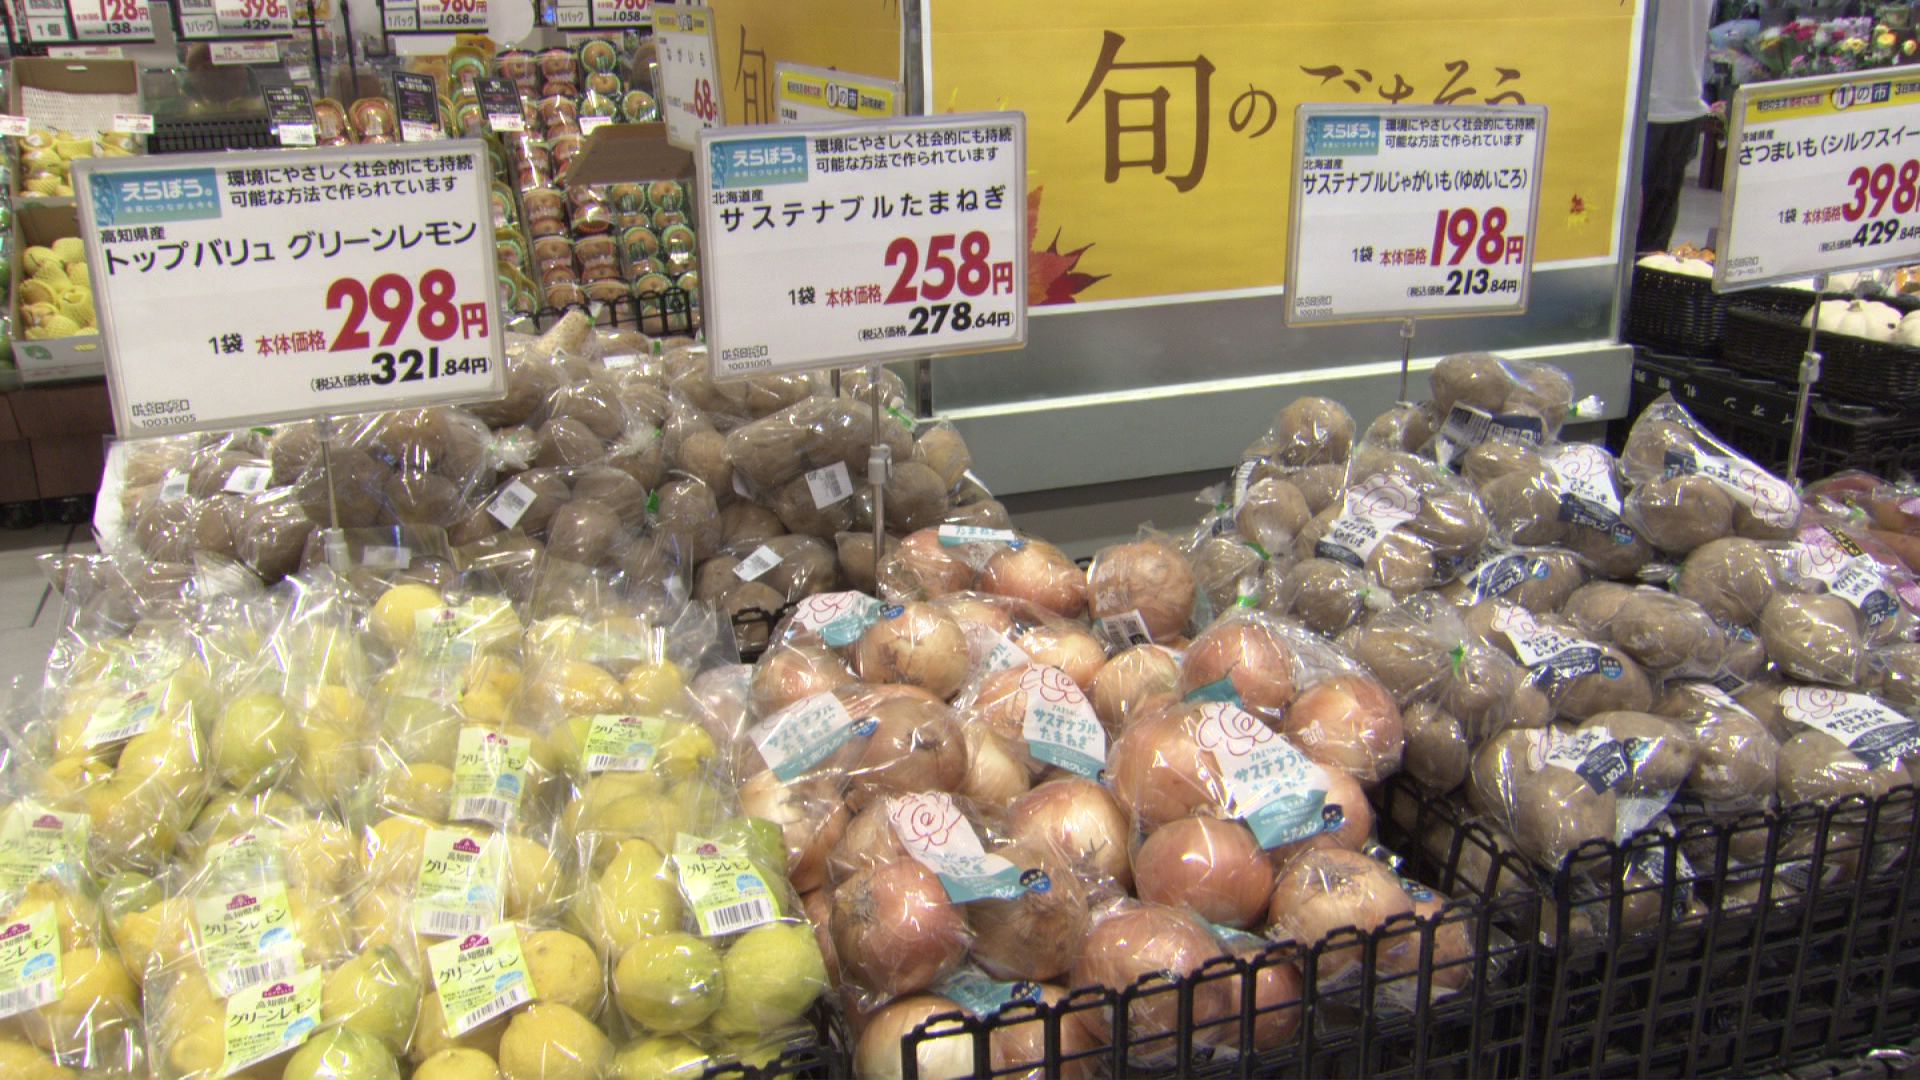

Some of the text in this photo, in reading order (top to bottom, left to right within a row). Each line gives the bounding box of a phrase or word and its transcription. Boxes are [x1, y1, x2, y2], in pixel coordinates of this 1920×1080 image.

[1385, 117, 1536, 132] 環境にやさしく社会的にも持続
[814, 127, 1012, 153] 環境にやさしく社会的にも持続
[1385, 134, 1525, 149] 可能な方法で作られています
[816, 147, 999, 173] 可能な方法で作られています
[1303, 158, 1344, 171] 北海道産
[226, 155, 473, 188] 環境にやさしく社会的にも持続
[230, 177, 458, 208] 可能な方法で作られています
[712, 189, 764, 206] 北海道産
[100, 226, 166, 244] 高知県産
[105, 221, 478, 275] トップバリュ グリーンレモン
[1351, 246, 1373, 263] 1袋
[788, 287, 816, 306] 1袋
[208, 333, 244, 356] 1袋
[440, 953, 519, 985] グリーンレモン
